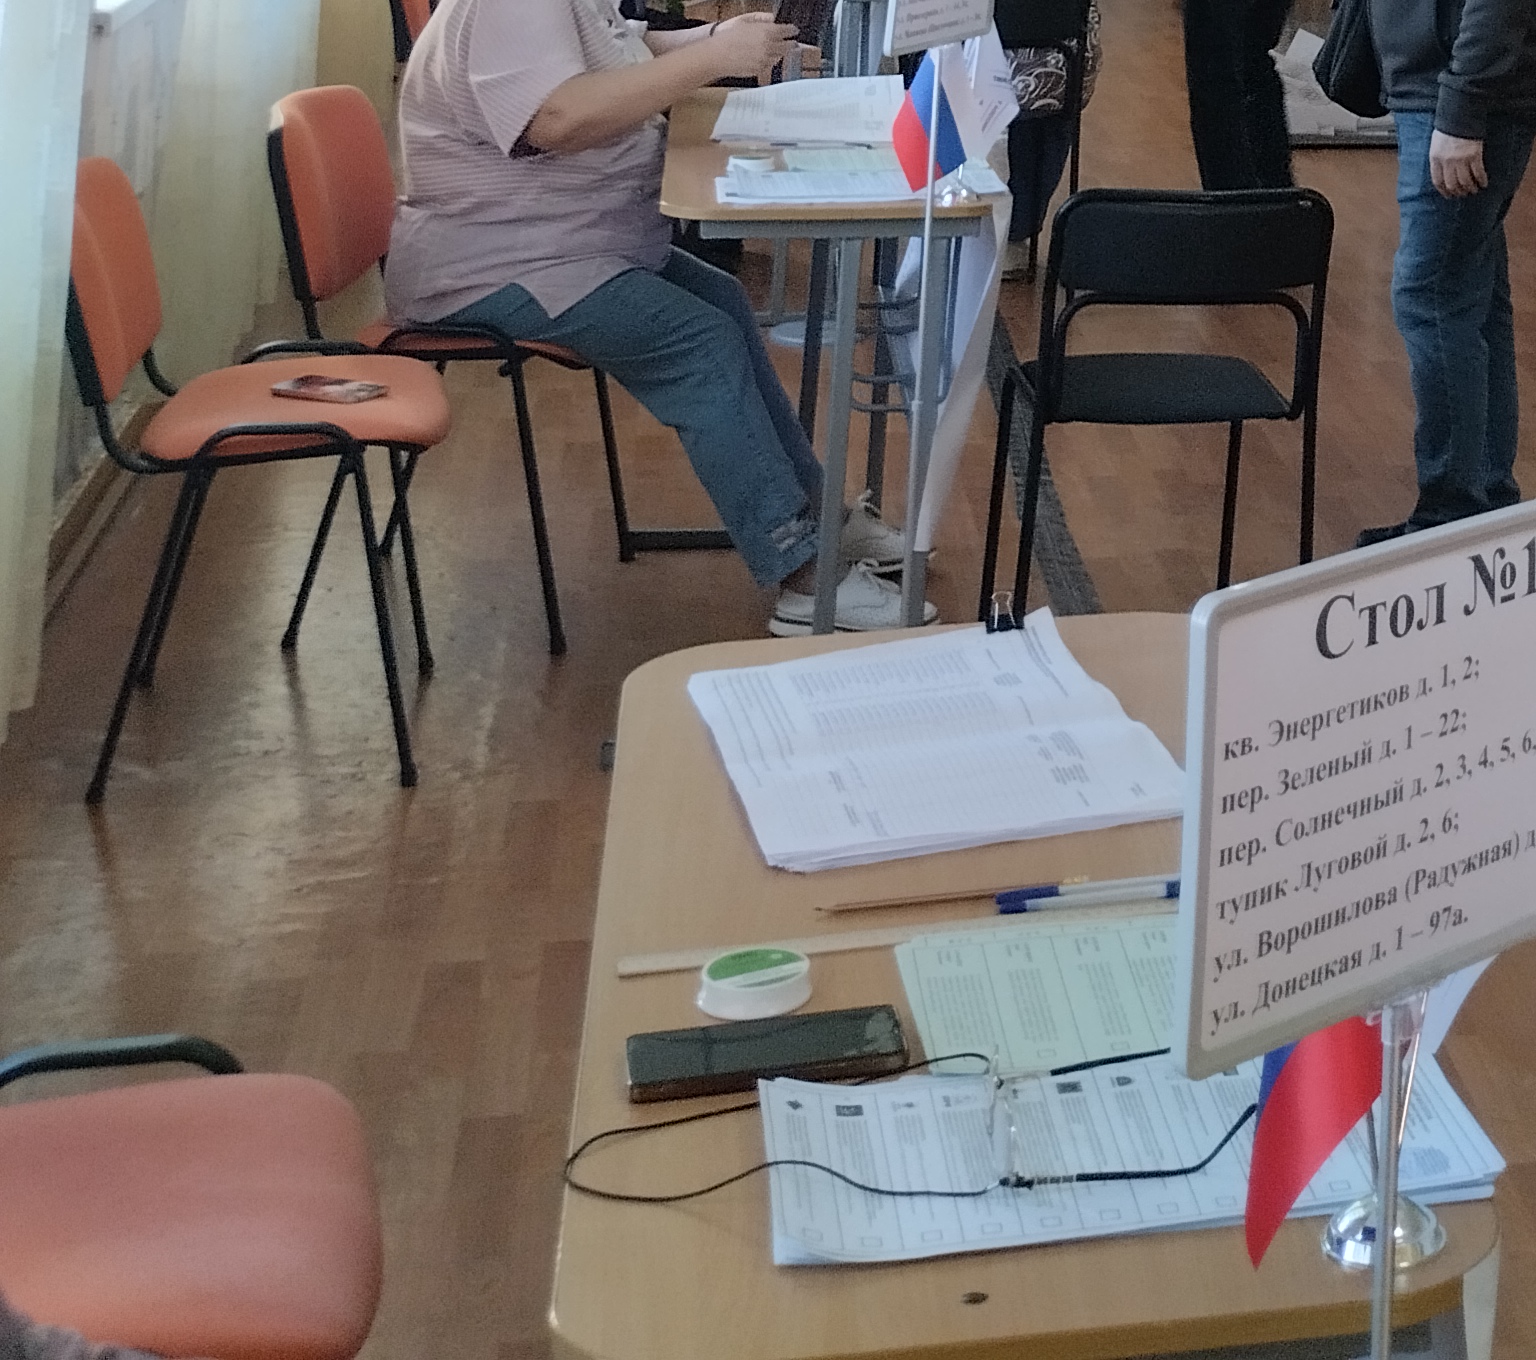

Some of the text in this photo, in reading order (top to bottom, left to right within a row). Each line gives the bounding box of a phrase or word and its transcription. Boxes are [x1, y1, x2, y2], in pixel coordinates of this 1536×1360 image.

[1315, 582, 1447, 660] Стол
[1220, 783, 1270, 814] пер.
[1277, 739, 1373, 796] Зеленый
[1378, 739, 1397, 762] д.
[1404, 725, 1413, 750] 1
[1438, 708, 1467, 737] 22;
[1223, 655, 1480, 761] кв. Энергетиков д. 1, 2;
[1218, 836, 1267, 867] пер.
[1275, 777, 1404, 847] Солнечный
[1409, 776, 1427, 801] д.
[1434, 762, 1450, 789] 2,
[1456, 754, 1472, 780] 3,
[1478, 745, 1495, 769] 4,
[1500, 736, 1516, 762] 5,
[1213, 948, 1248, 983] ул.
[1256, 883, 1398, 959] Ворошилова
[1405, 830, 1520, 902] (Радужная)
[1215, 807, 1459, 925] тупик Луговой д. 2, 6;
[1210, 1000, 1246, 1036] ул.
[1252, 948, 1363, 1017] Донецкая
[1368, 940, 1387, 965] д.
[1396, 925, 1403, 951] 1
[1429, 905, 1468, 936] 97а.
